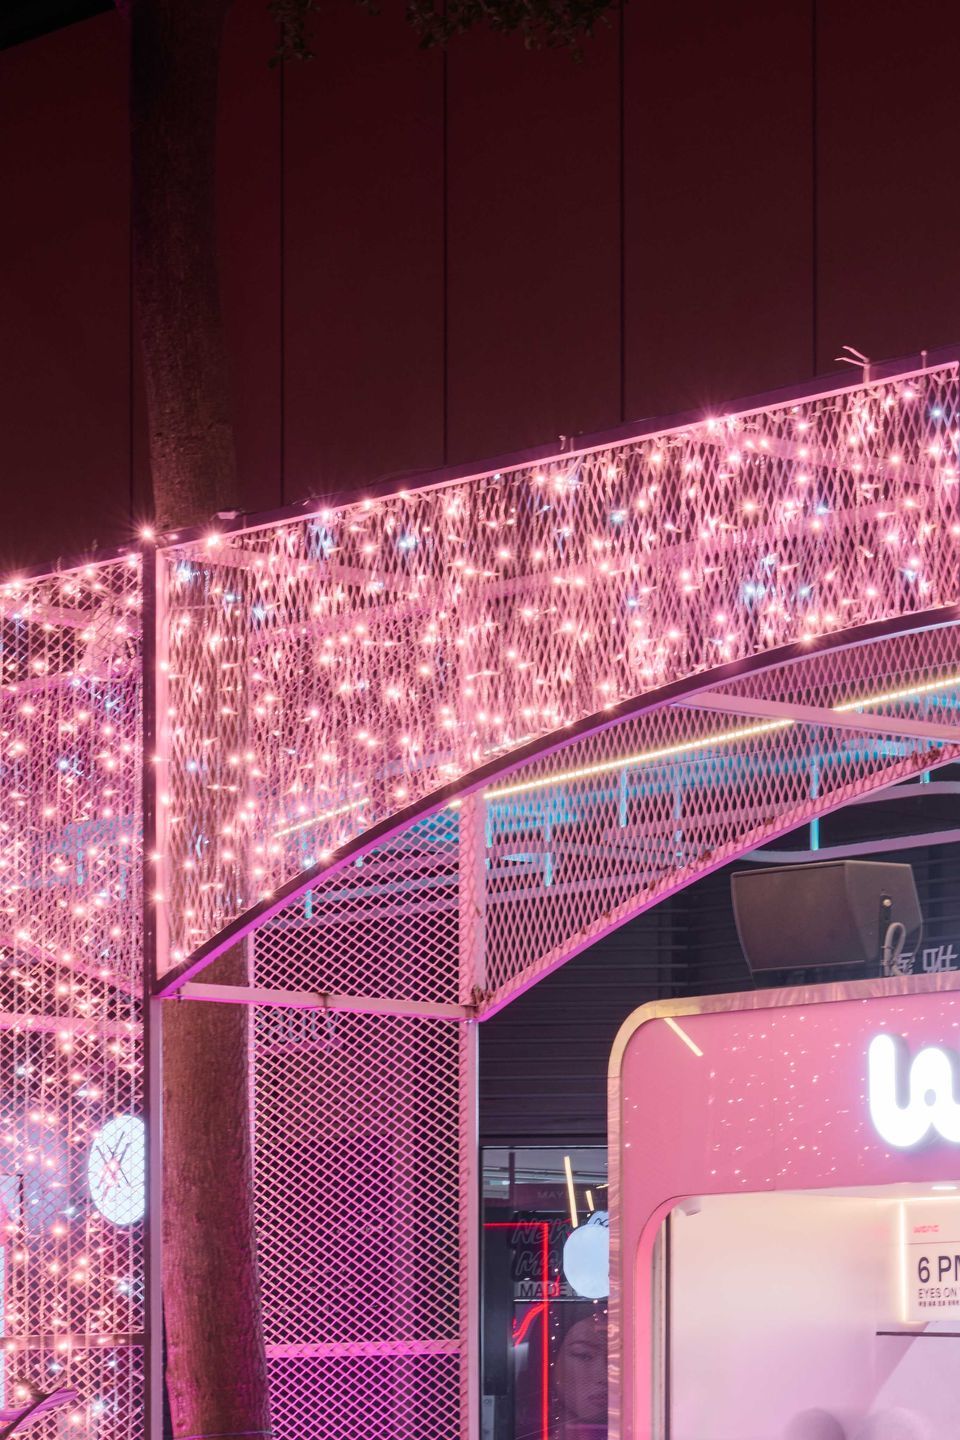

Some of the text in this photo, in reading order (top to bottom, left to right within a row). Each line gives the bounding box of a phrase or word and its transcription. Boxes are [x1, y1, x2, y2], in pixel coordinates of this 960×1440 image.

[918, 1256, 931, 1283] 6
[918, 1287, 942, 1299] EYES
[943, 1286, 957, 1298] ON
